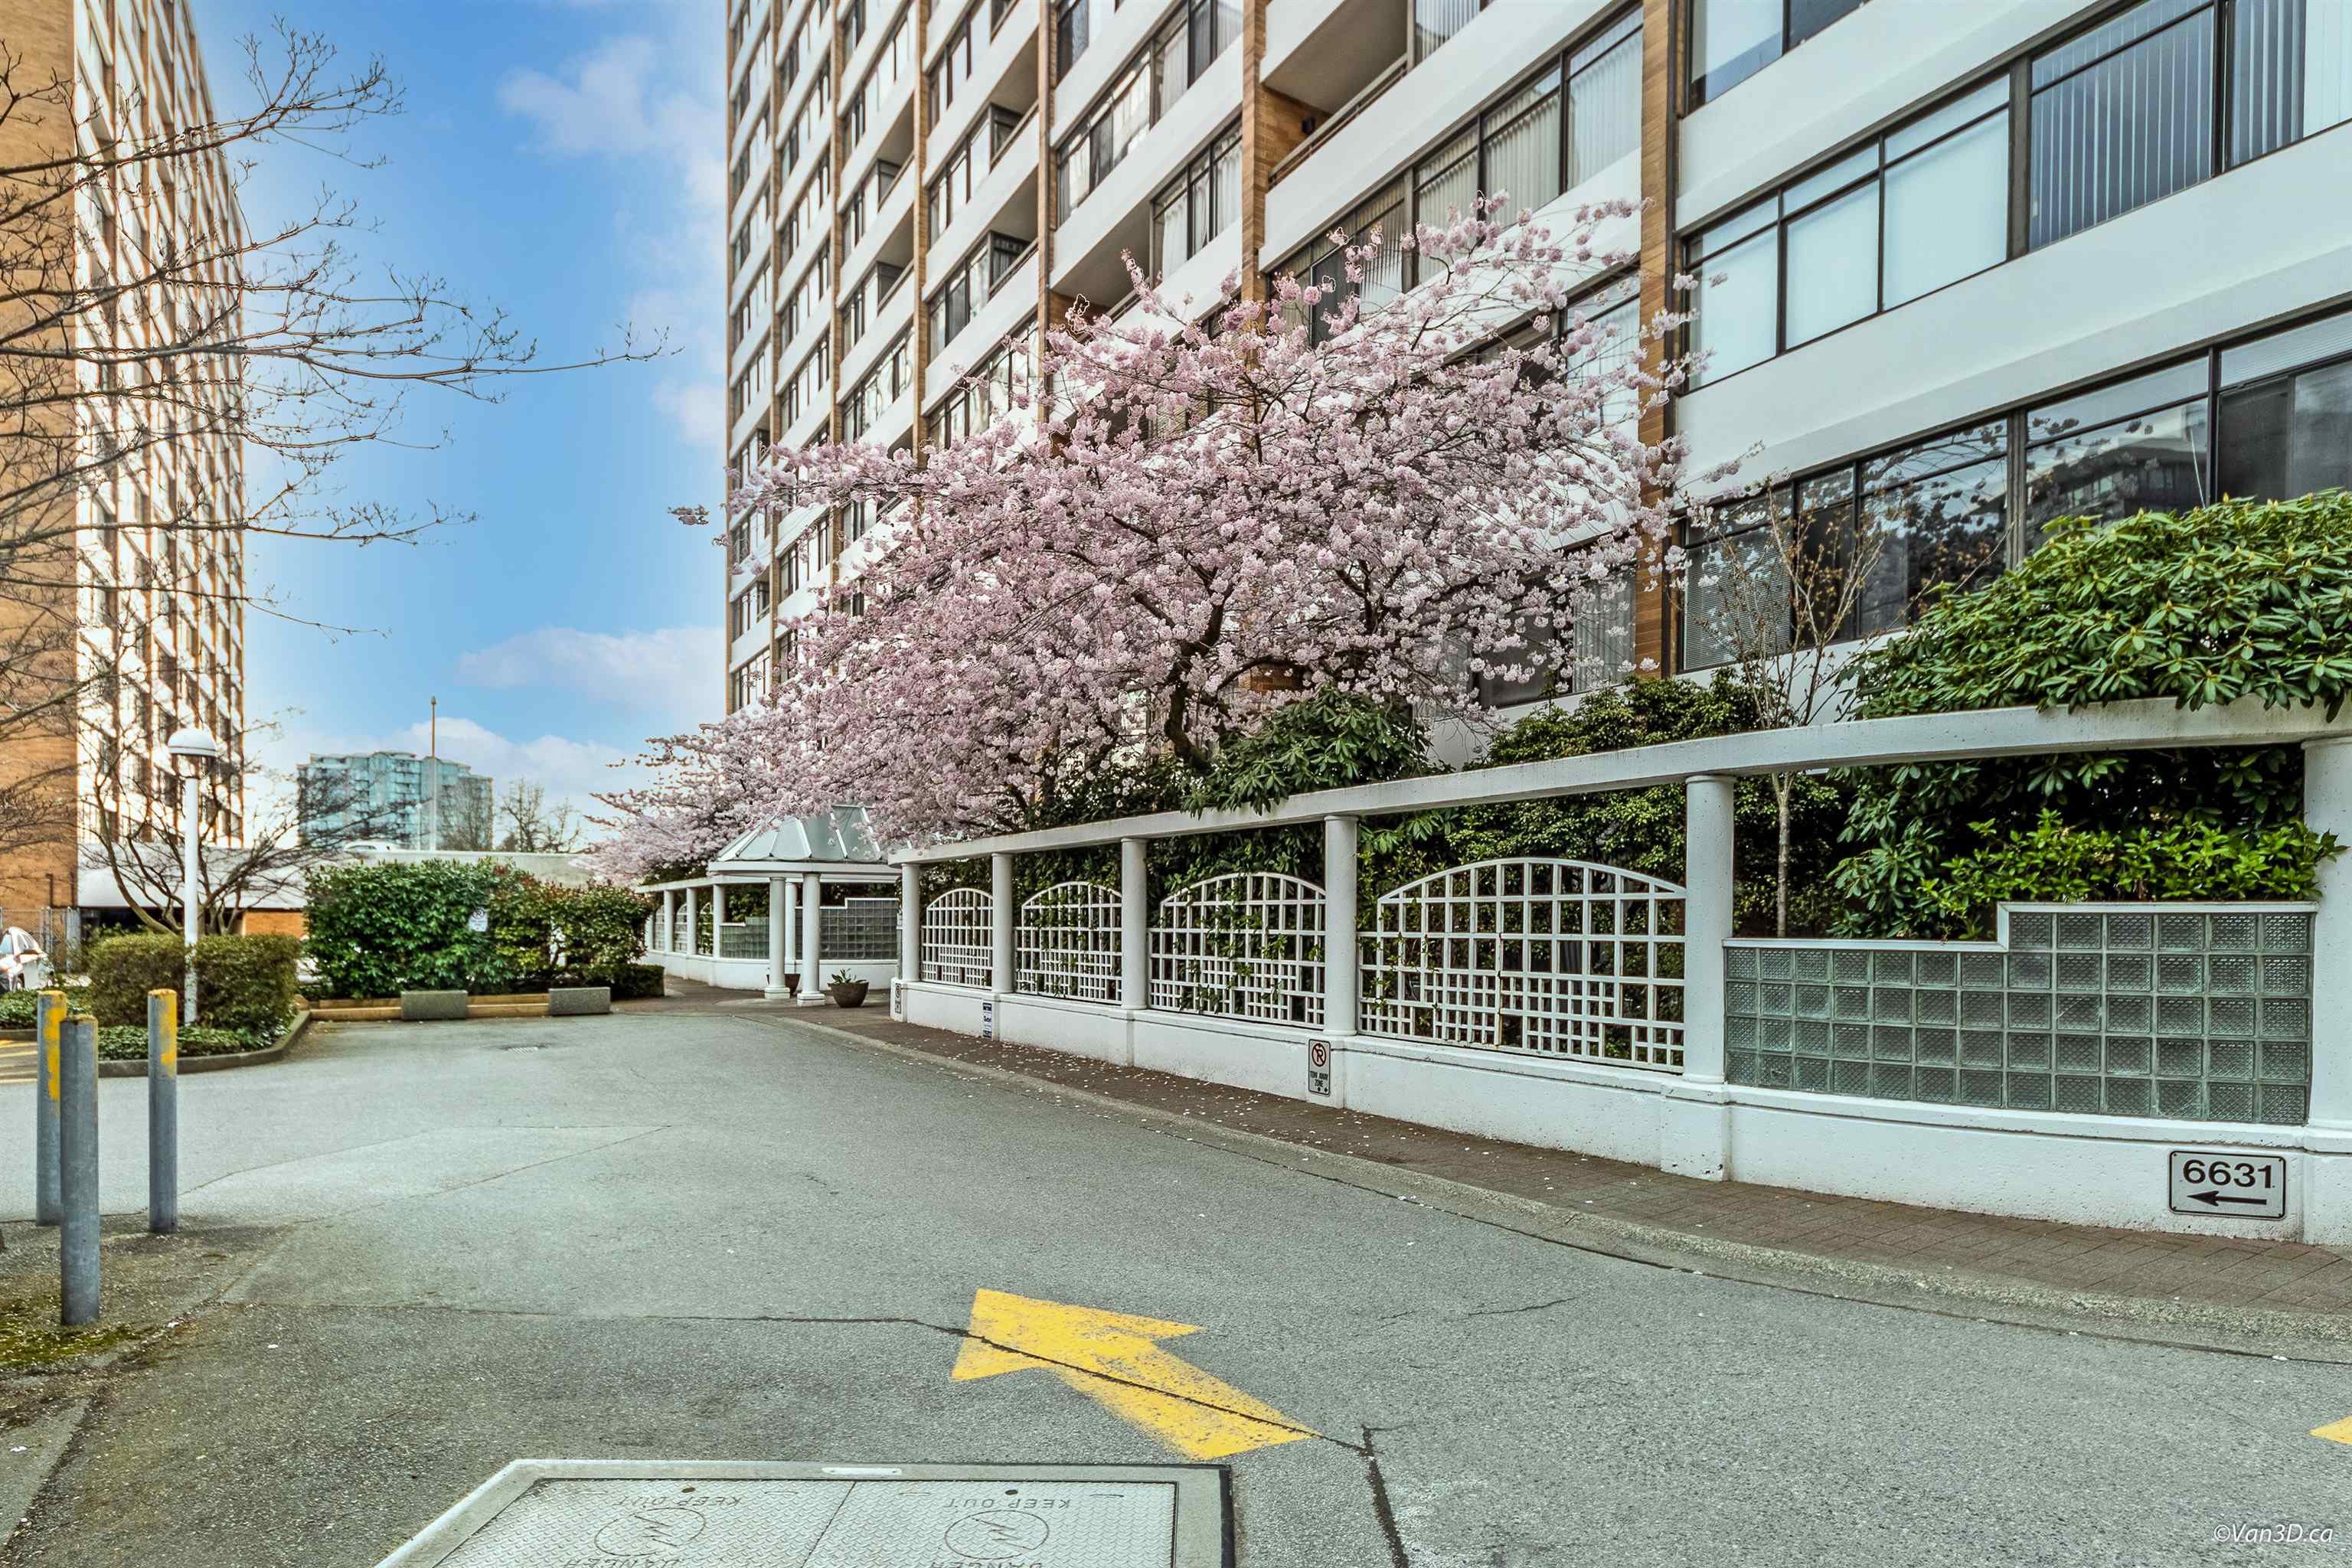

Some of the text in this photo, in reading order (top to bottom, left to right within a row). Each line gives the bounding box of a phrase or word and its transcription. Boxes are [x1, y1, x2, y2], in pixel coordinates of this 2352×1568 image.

[2182, 1158, 2273, 1189] 6631
[675, 1496, 742, 1507] KEEP
[946, 1498, 1071, 1509] KEEP OUT
